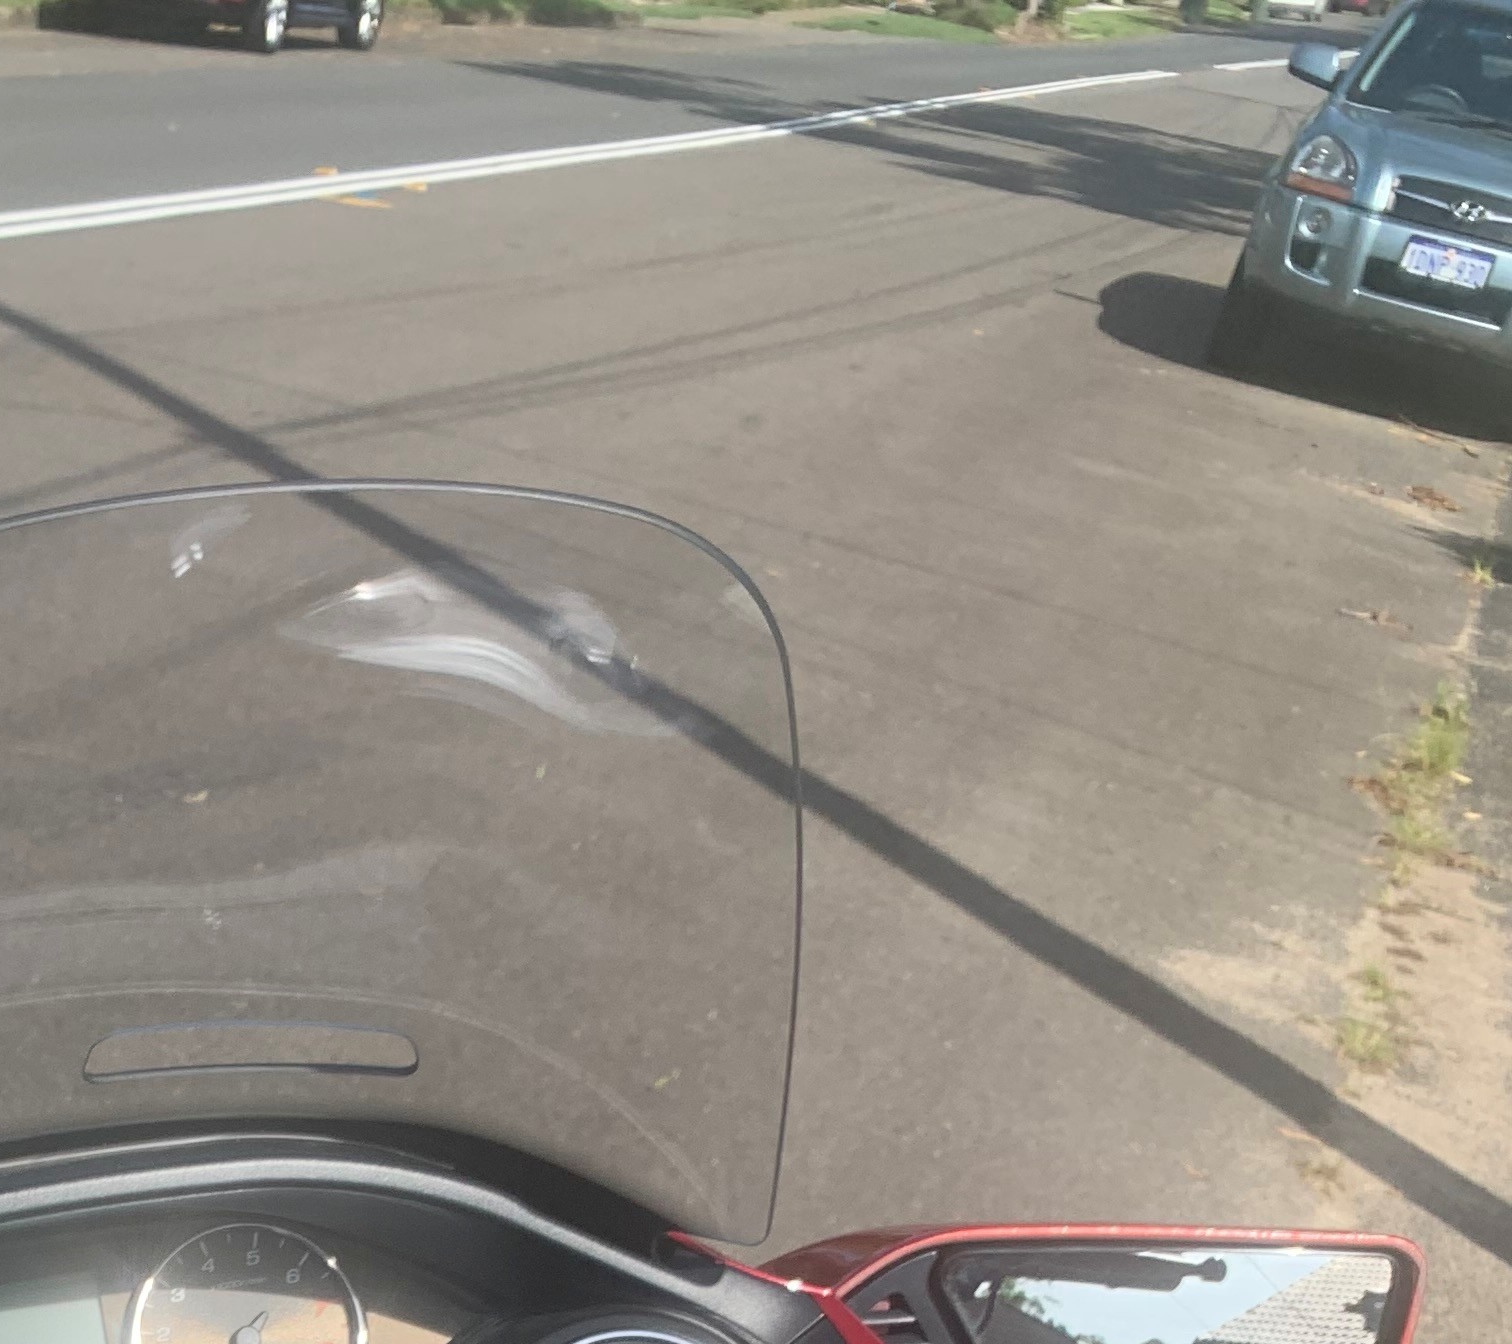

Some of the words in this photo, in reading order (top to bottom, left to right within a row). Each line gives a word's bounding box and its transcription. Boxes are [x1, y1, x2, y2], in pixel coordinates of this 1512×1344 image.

[201, 1258, 215, 1273] 4
[246, 1250, 260, 1267] 5
[286, 1268, 300, 1284] 6
[170, 1287, 186, 1302] 3
[156, 1328, 170, 1342] 2
